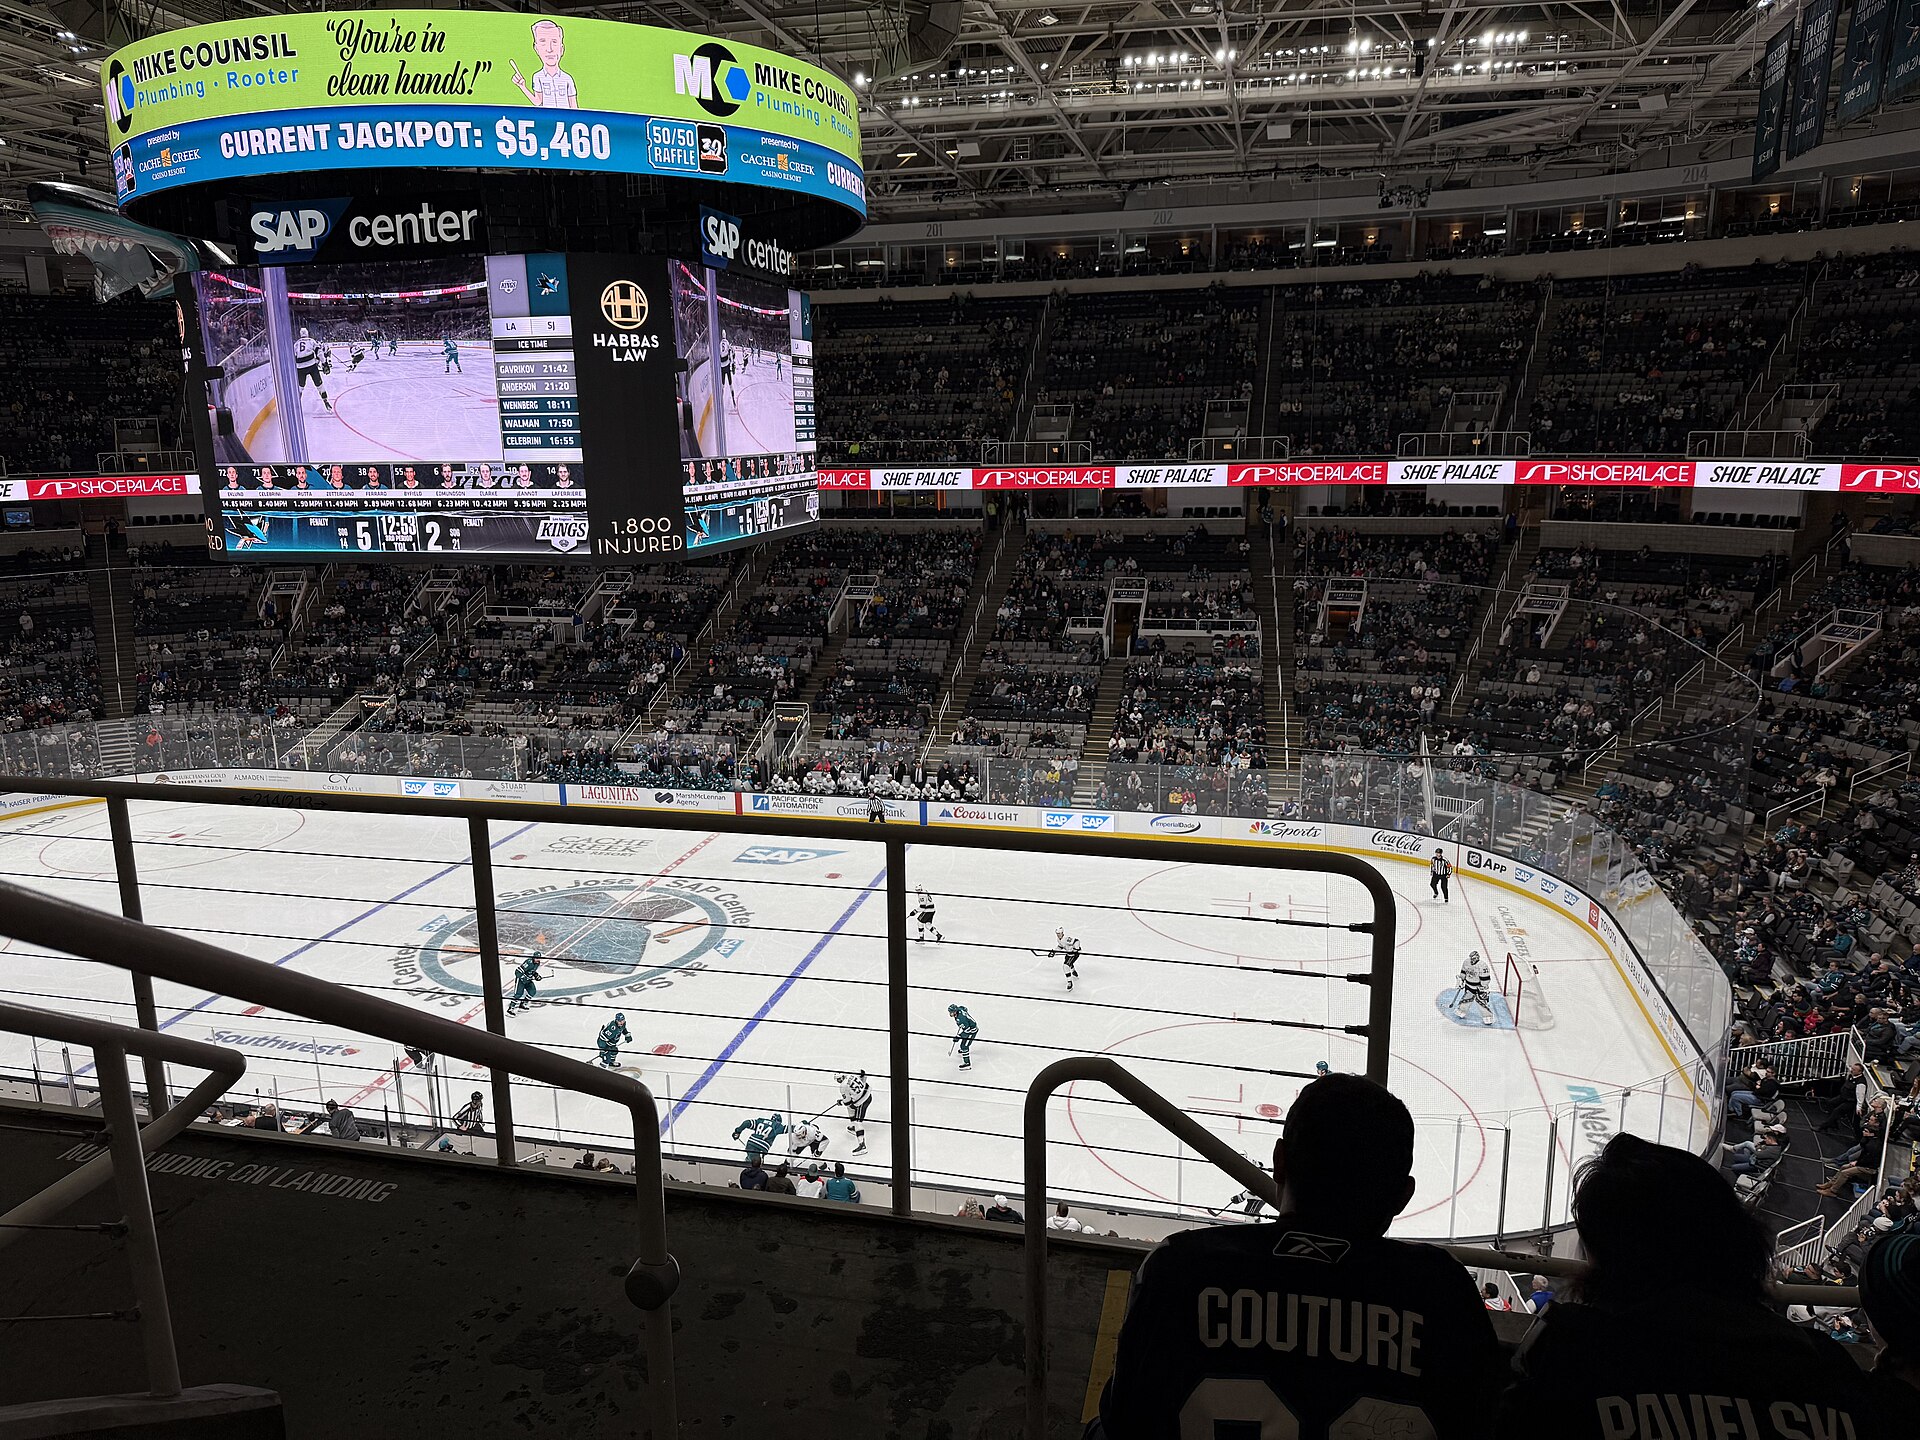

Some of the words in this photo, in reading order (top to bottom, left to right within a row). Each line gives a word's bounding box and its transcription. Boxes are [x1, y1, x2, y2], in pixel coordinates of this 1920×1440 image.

[421, 22, 446, 53] in
[132, 49, 178, 84] MIKE
[182, 33, 297, 71] COUNSIL
[327, 61, 391, 97] clean
[138, 79, 206, 108] Plumbing
[227, 68, 300, 88] Rooter
[754, 62, 801, 95] MIKE
[804, 78, 852, 120] COUNSIL
[756, 92, 820, 126] Plumbing
[831, 115, 853, 139] Rooter
[147, 133, 172, 148] presented
[172, 130, 180, 140] by
[220, 123, 331, 159] CURRENT
[338, 121, 483, 149] JACKPOT:
[495, 116, 610, 160] $5,460
[653, 126, 695, 148] 50/50
[761, 136, 791, 149] presented
[791, 141, 800, 152] by
[139, 156, 161, 172] CACHE
[171, 149, 201, 163] CREEK
[654, 147, 696, 165] RAFFLE
[741, 153, 777, 168] CACHE
[789, 161, 815, 176] CREEK
[761, 169, 783, 179] CASINO
[1682, 165, 1709, 184] 204
[1153, 210, 1173, 225] 202
[251, 209, 325, 252] SAP
[349, 202, 477, 247] center
[926, 223, 943, 237] 201
[707, 216, 740, 259] SAP
[748, 238, 792, 276] center
[547, 321, 555, 331] SJ
[530, 340, 548, 348] TIME
[593, 333, 659, 348] HABBAS
[613, 348, 648, 363] LAW
[500, 365, 535, 374] GAVRIKOV
[543, 364, 568, 372] 21:42
[501, 382, 537, 391] ANDERSON
[544, 382, 570, 390] 21:20
[502, 401, 538, 410] WENNBERG
[547, 401, 571, 409] 18:11
[504, 419, 540, 428] WALMAN
[548, 419, 573, 427] 17:50
[506, 437, 541, 445] CELEBRINI
[549, 436, 574, 445] 16:55
[219, 469, 226, 477] 72
[322, 468, 330, 476] 20
[358, 468, 367, 476] 38
[881, 472, 914, 486] SHOE
[915, 472, 961, 486] PALACE
[1127, 468, 1163, 483] SHOE
[1163, 468, 1215, 483] PALACE
[1400, 464, 1441, 480] SHOE
[1443, 464, 1502, 480] PALACE
[1710, 465, 1756, 483] SHOE
[1757, 467, 1825, 485] PALACE
[820, 473, 866, 487] PALACE
[240, 500, 253, 508] MPH
[272, 500, 287, 508] MPH
[294, 500, 308, 508] 1.90
[308, 500, 323, 508] MPH
[325, 500, 344, 508] 11.49
[344, 500, 358, 508] MPH
[364, 500, 380, 508] 9.89
[380, 500, 395, 508] MPH
[417, 500, 431, 508] MPH
[454, 500, 470, 508] MPH
[472, 500, 492, 508] 10.42
[492, 500, 508, 508] MPH
[531, 500, 546, 508] MPH
[552, 500, 570, 508] 2.25
[571, 500, 587, 508] MPH
[746, 508, 752, 535] 5
[771, 504, 778, 530] 2
[381, 516, 416, 535] 12:53
[541, 522, 587, 537] KINGS
[611, 517, 671, 535] 1.800
[356, 521, 372, 550] 5
[426, 522, 443, 550] 2
[340, 539, 348, 549] 14
[452, 539, 460, 550] 21
[598, 535, 683, 555] INJURED
[405, 782, 422, 794] SAP
[434, 783, 450, 795] SAP
[581, 786, 639, 801] LAGUNITAS
[8, 798, 31, 808] KAISER
[953, 807, 987, 819] Coors
[988, 812, 1018, 821] LIGHT
[1046, 814, 1068, 826] SAP
[1082, 816, 1104, 828] SAP
[1270, 822, 1322, 838] Sports
[548, 842, 641, 853] CREEK
[559, 836, 653, 846] CACHE
[738, 849, 817, 862] SAP
[1515, 870, 1531, 882] SAP
[497, 885, 557, 900] San
[565, 879, 634, 889] Jose
[665, 879, 721, 893] SAP
[1541, 880, 1555, 893] SAP
[1564, 892, 1577, 905] SAP
[1600, 917, 1617, 947] TOYOTA
[604, 976, 674, 999] San
[204, 1031, 343, 1056] Southwest
[756, 1123, 773, 1140] 84
[227, 1164, 279, 1185] ON
[269, 1169, 398, 1203] LANDING
[1198, 1287, 1424, 1377] COUTURE
